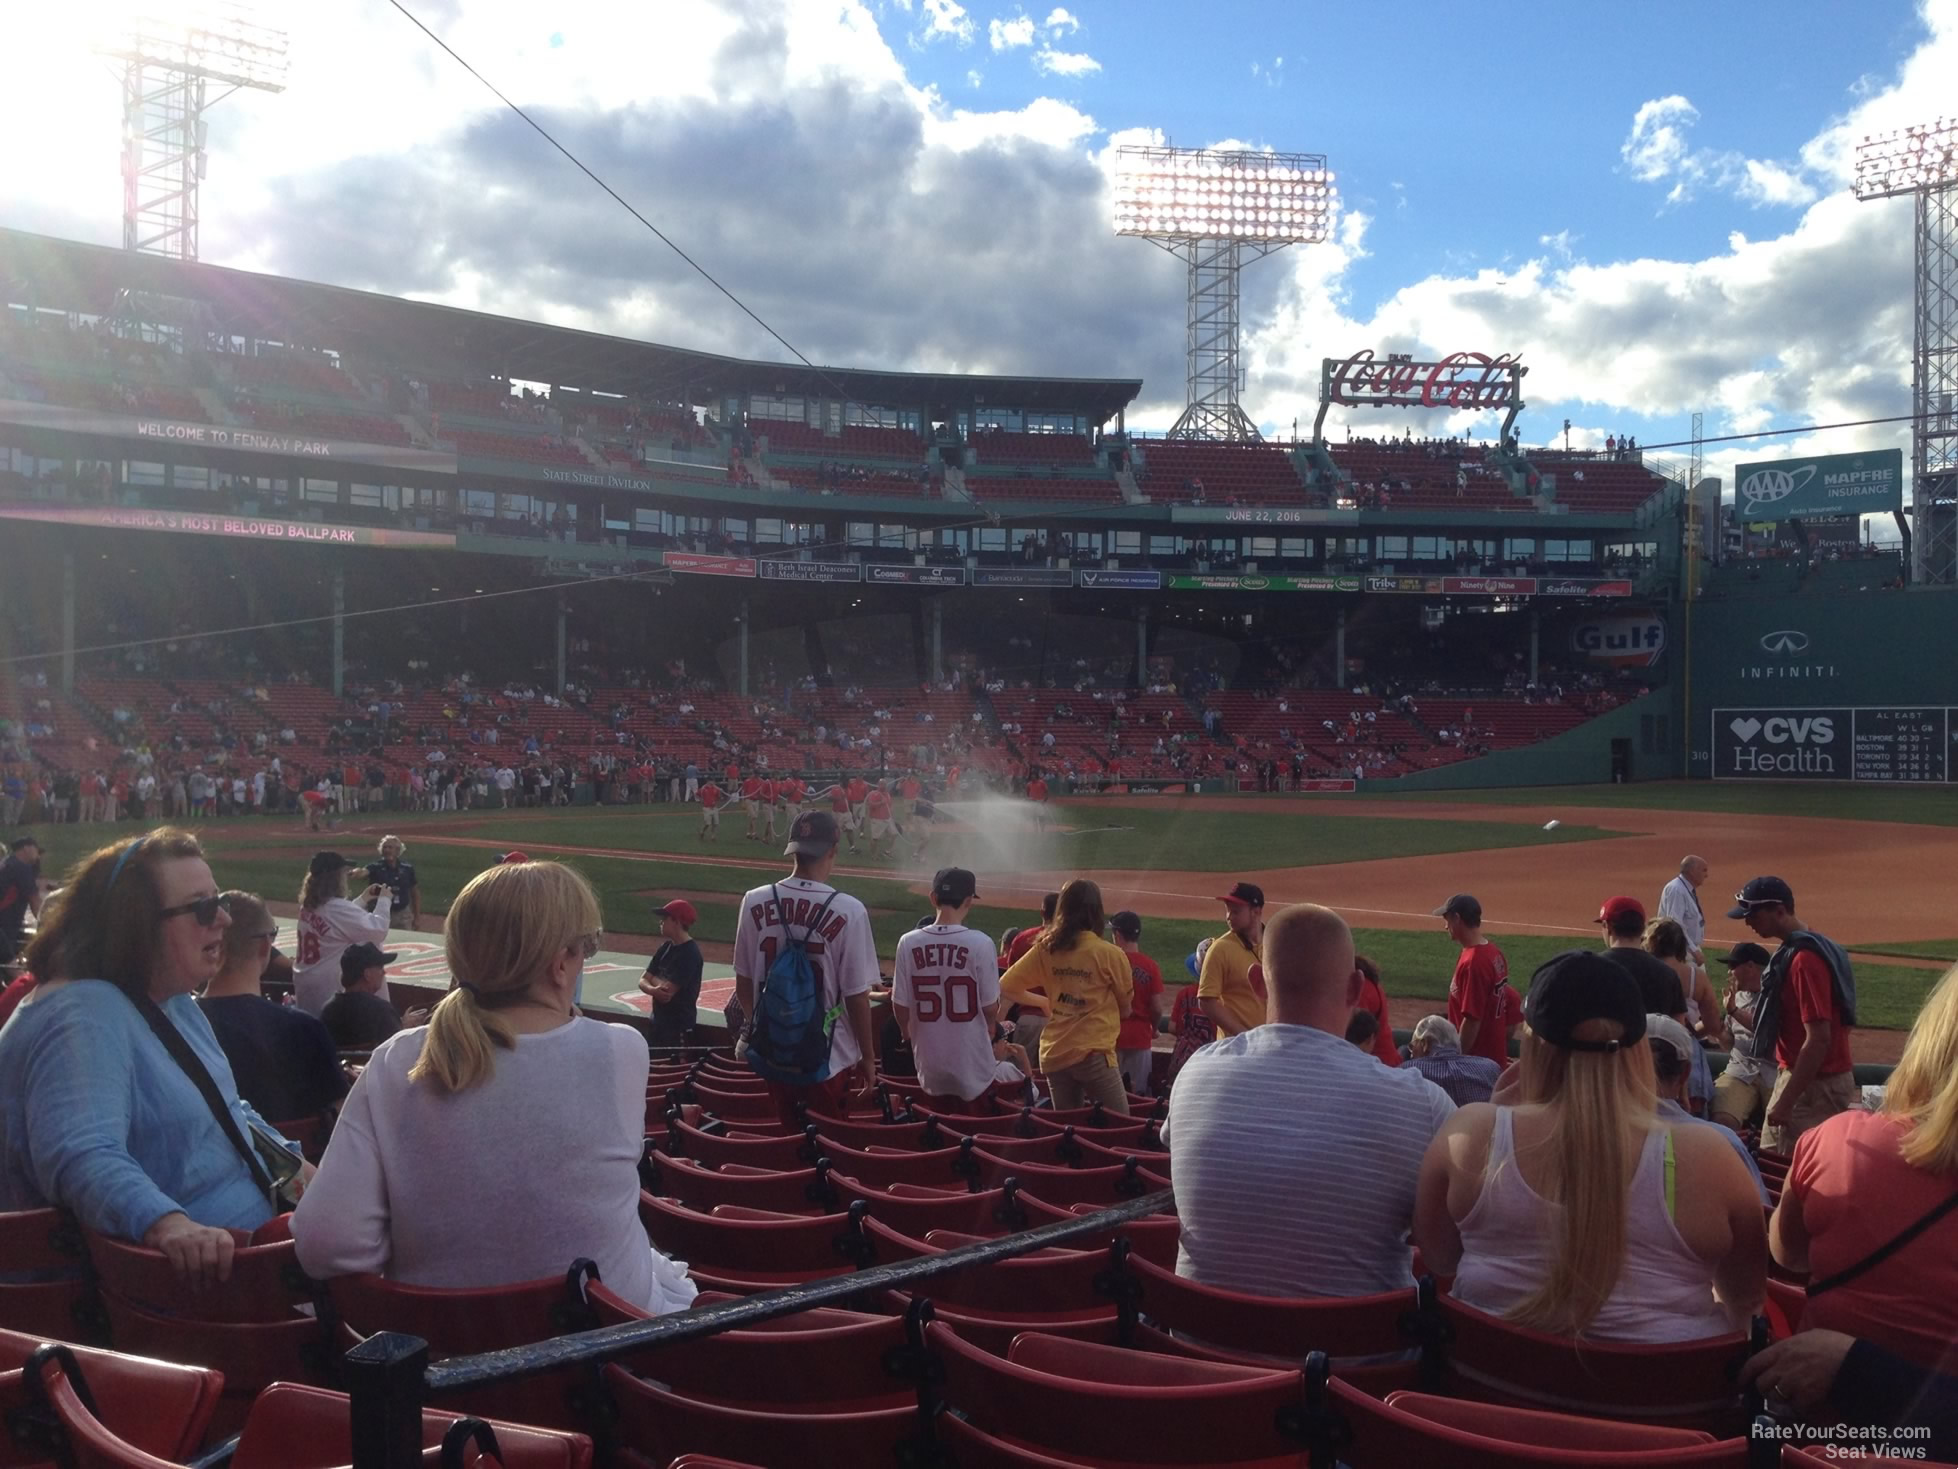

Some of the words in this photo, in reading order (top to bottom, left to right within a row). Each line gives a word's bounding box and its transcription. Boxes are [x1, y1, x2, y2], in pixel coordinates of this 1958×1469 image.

[1331, 349, 1523, 408] Coca-Cola
[138, 422, 205, 441] WELCOME
[211, 429, 228, 443] TO
[233, 433, 290, 452] FENWAY
[294, 440, 331, 456] PARK
[543, 468, 570, 482] STATE
[572, 471, 605, 485] STREET
[607, 475, 650, 490] PAVILION
[1748, 470, 1789, 501] AAA
[1824, 468, 1894, 485] MAPFRE
[1828, 484, 1889, 498] INSURANCE
[102, 512, 177, 528] AMERICA'S
[181, 516, 218, 532] MOST
[224, 520, 284, 537] BELOVED
[288, 525, 356, 542] BALLPARK
[1225, 511, 1252, 522] JUNE
[1255, 511, 1273, 524] 22,
[1276, 511, 1301, 522] 2016
[778, 563, 794, 572] Beth
[797, 563, 818, 573] Israel
[778, 571, 807, 580] Medical
[809, 572, 834, 581] Center
[1368, 577, 1396, 591] Tribe
[1460, 581, 1484, 591] Ninety
[1498, 582, 1515, 590] Nine
[1576, 625, 1660, 650] Gulf
[1741, 666, 1835, 678] INFINITI
[1763, 717, 1835, 744] CVS
[1692, 751, 1709, 761] 310
[1733, 746, 1835, 773] Health
[750, 897, 847, 943] PEDROIA
[911, 943, 970, 970] BETTS
[911, 975, 978, 1023] 50
